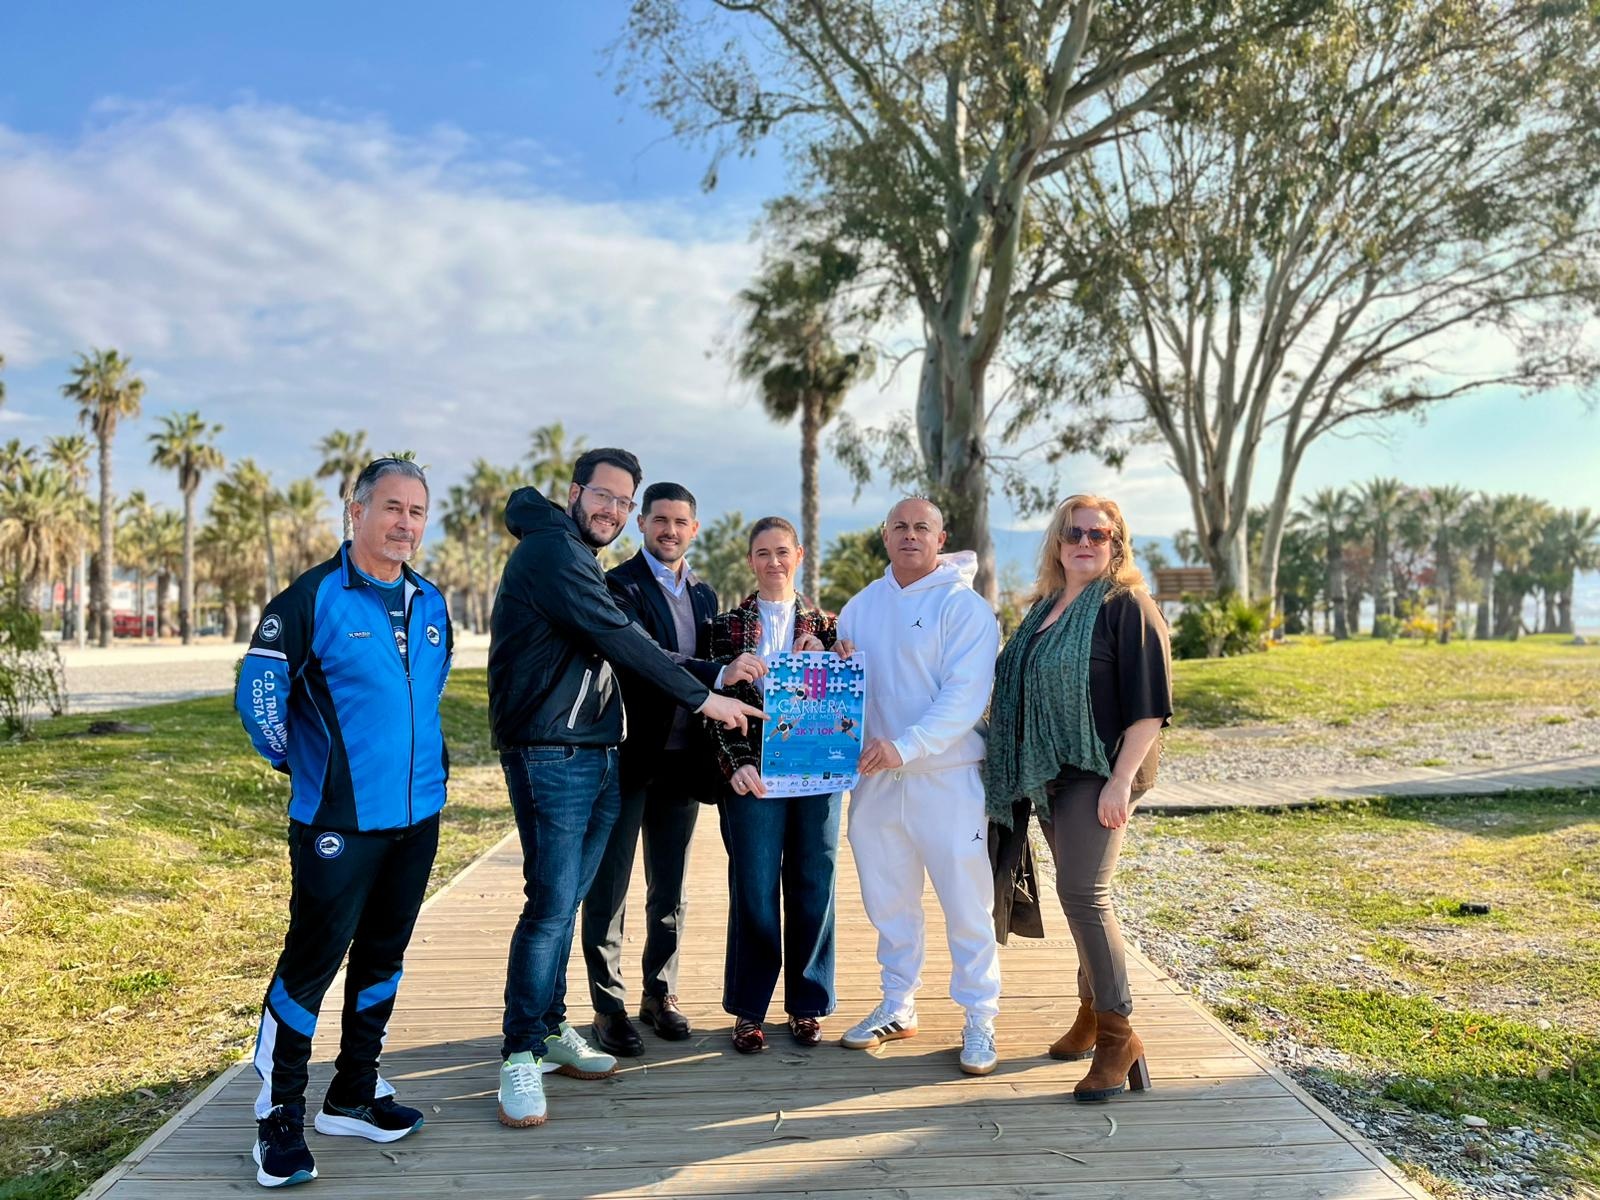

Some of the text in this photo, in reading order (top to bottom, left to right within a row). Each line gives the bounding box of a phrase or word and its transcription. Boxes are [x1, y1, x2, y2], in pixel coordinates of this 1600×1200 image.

[264, 670, 275, 694] C.D.
[252, 679, 265, 718] COSTA
[265, 696, 279, 726] TRAIL
[778, 699, 847, 714] CARRERA
